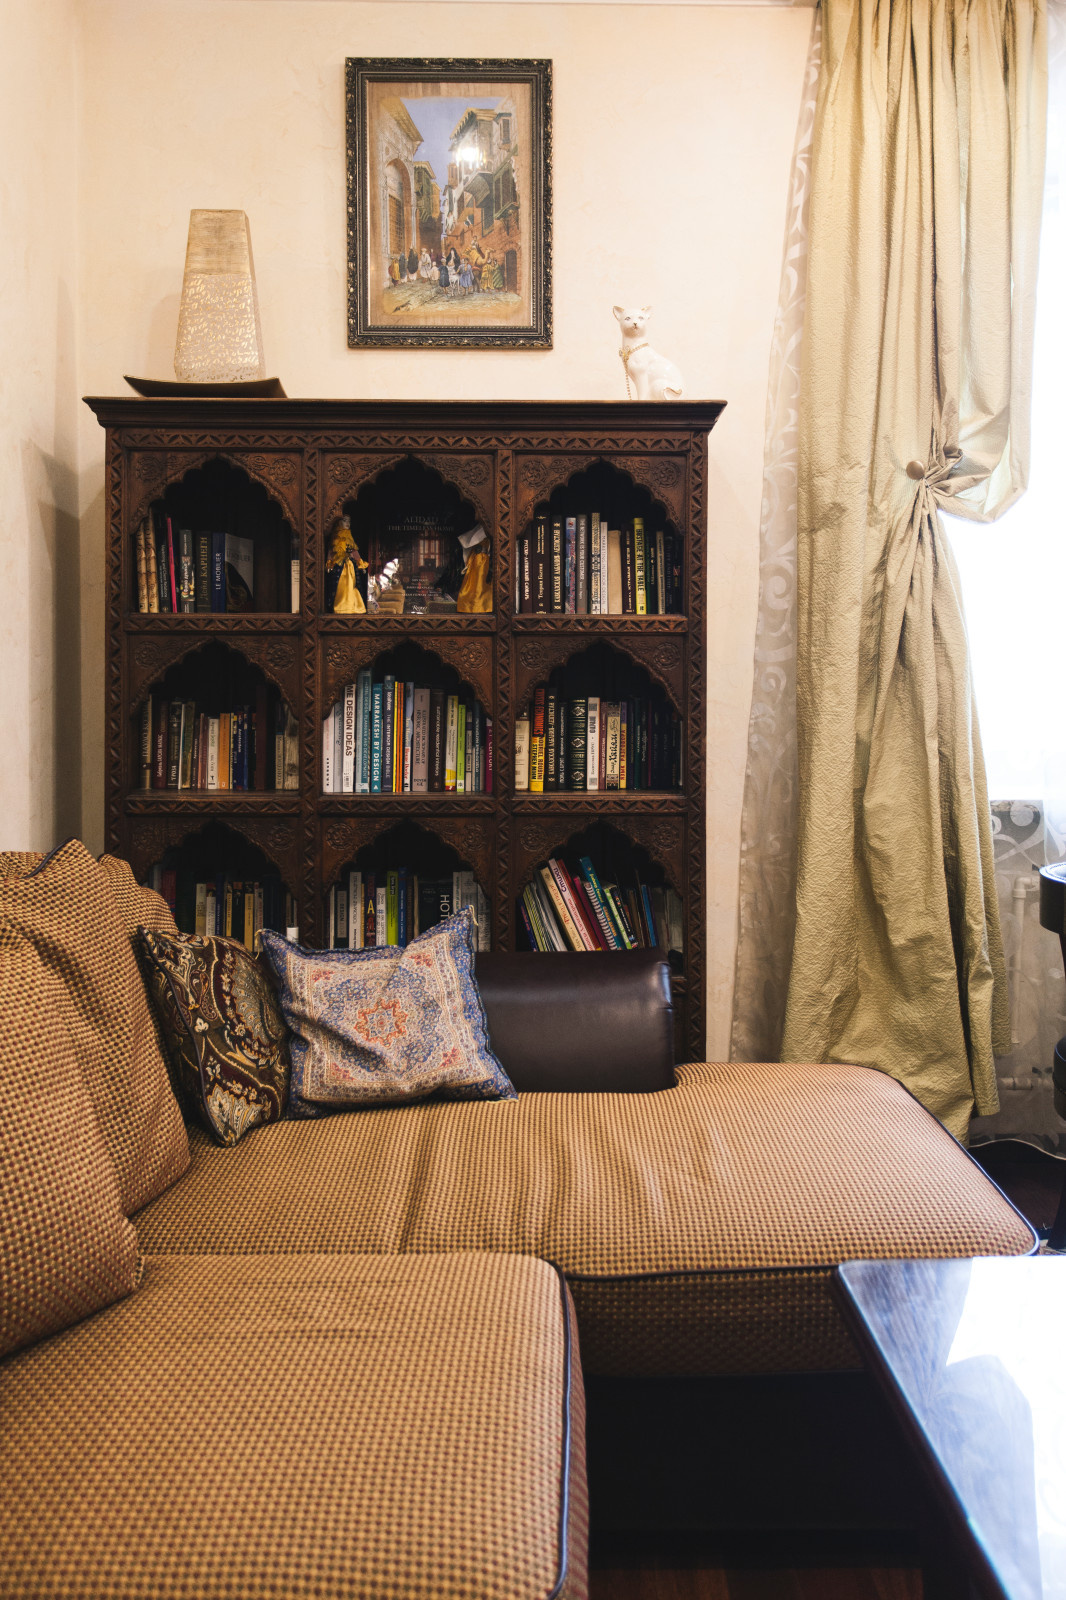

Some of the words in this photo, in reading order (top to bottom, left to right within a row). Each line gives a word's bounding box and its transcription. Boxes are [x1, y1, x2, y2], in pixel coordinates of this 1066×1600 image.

[200, 536, 208, 578] КАРНЕГИ
[535, 688, 544, 705] CRISIS
[534, 706, 544, 735] ECONOMICS
[374, 741, 380, 750] BY
[608, 734, 618, 762] Хайям
[554, 868, 566, 892] Стихи
[440, 894, 450, 919] HOT
